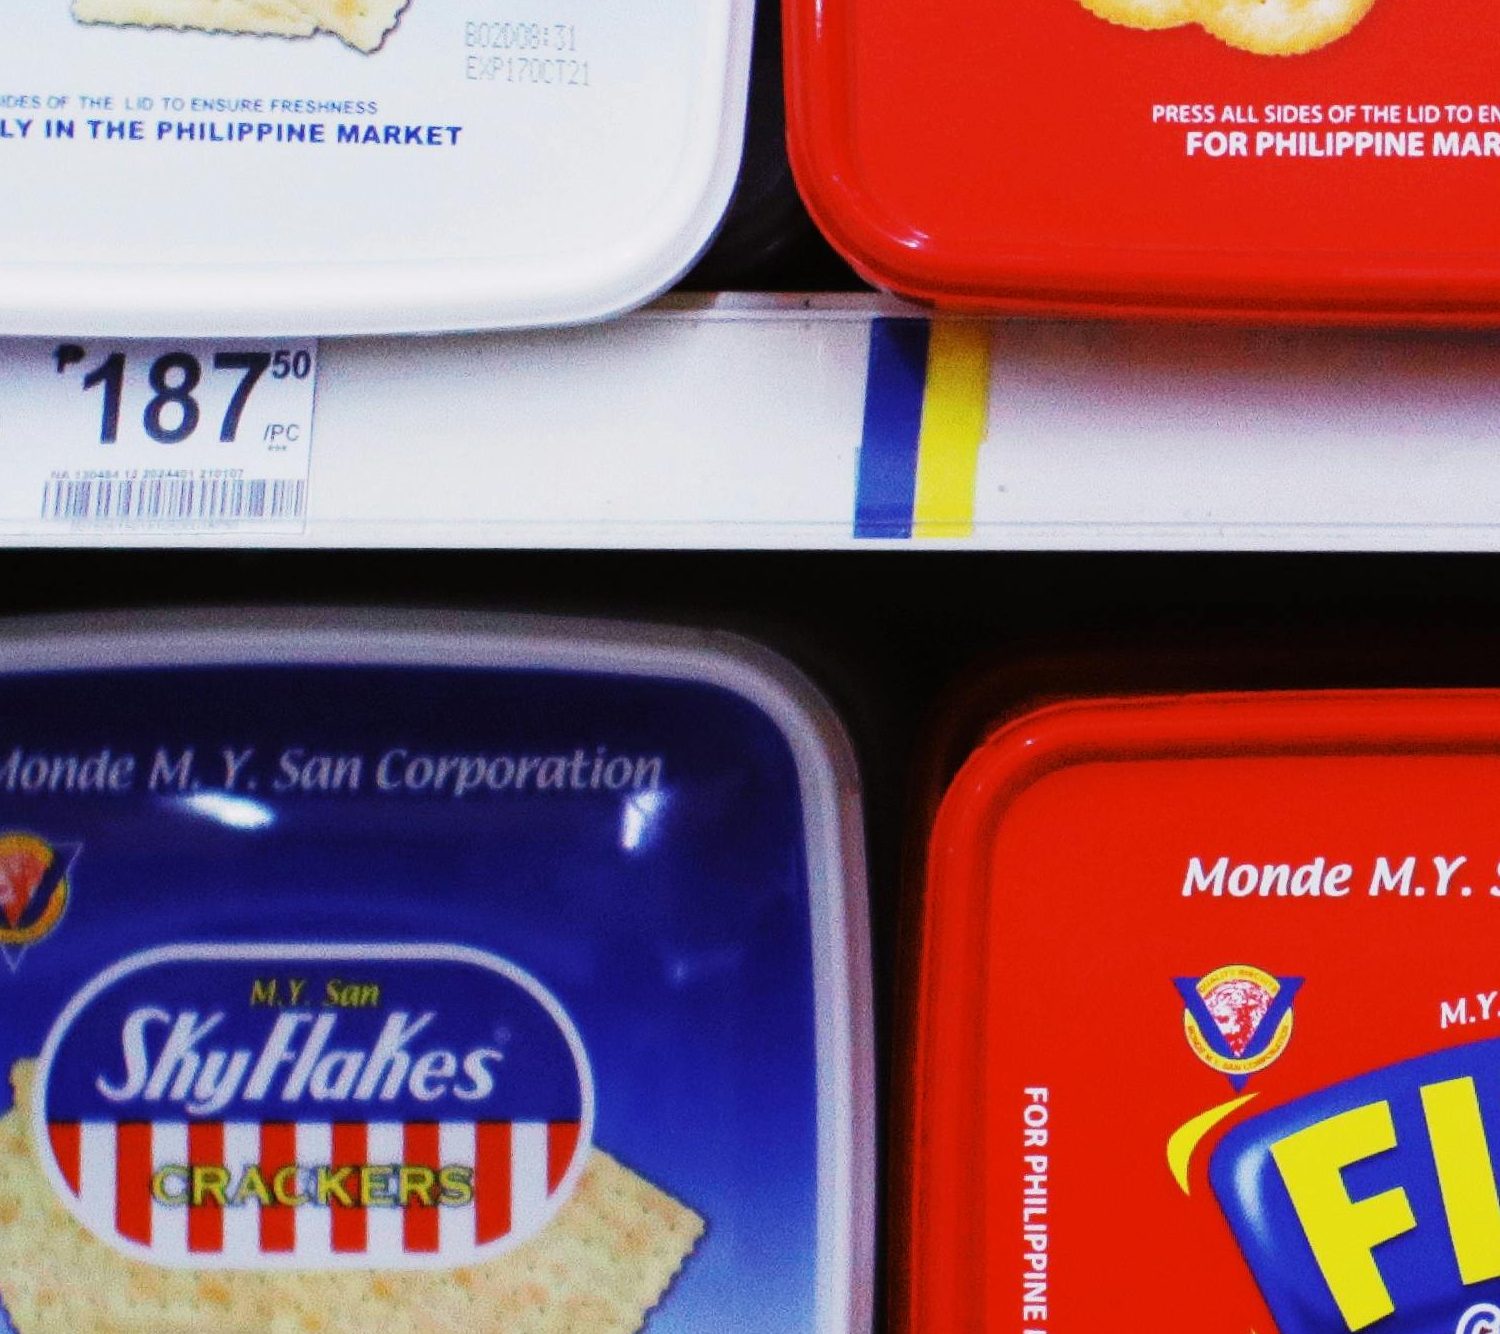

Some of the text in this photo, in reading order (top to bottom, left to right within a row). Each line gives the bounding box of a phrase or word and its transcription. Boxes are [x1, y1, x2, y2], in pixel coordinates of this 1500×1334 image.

[47, 96, 67, 108] OF
[81, 96, 111, 109] THE
[125, 97, 153, 111] LID
[162, 97, 185, 111] TO
[191, 98, 262, 112] ENSURE
[271, 99, 377, 114] FRESHNESS
[46, 120, 74, 138] IN
[88, 120, 143, 140] THE
[158, 122, 323, 143] PHILIPPINE
[338, 124, 462, 145] MARKET
[270, 349, 311, 378] 50
[1182, 857, 1352, 896] Monde
[1367, 856, 1475, 901] M.Y.
[95, 1005, 506, 1116] SkyFlakes
[151, 1164, 474, 1210] CRACKERS
